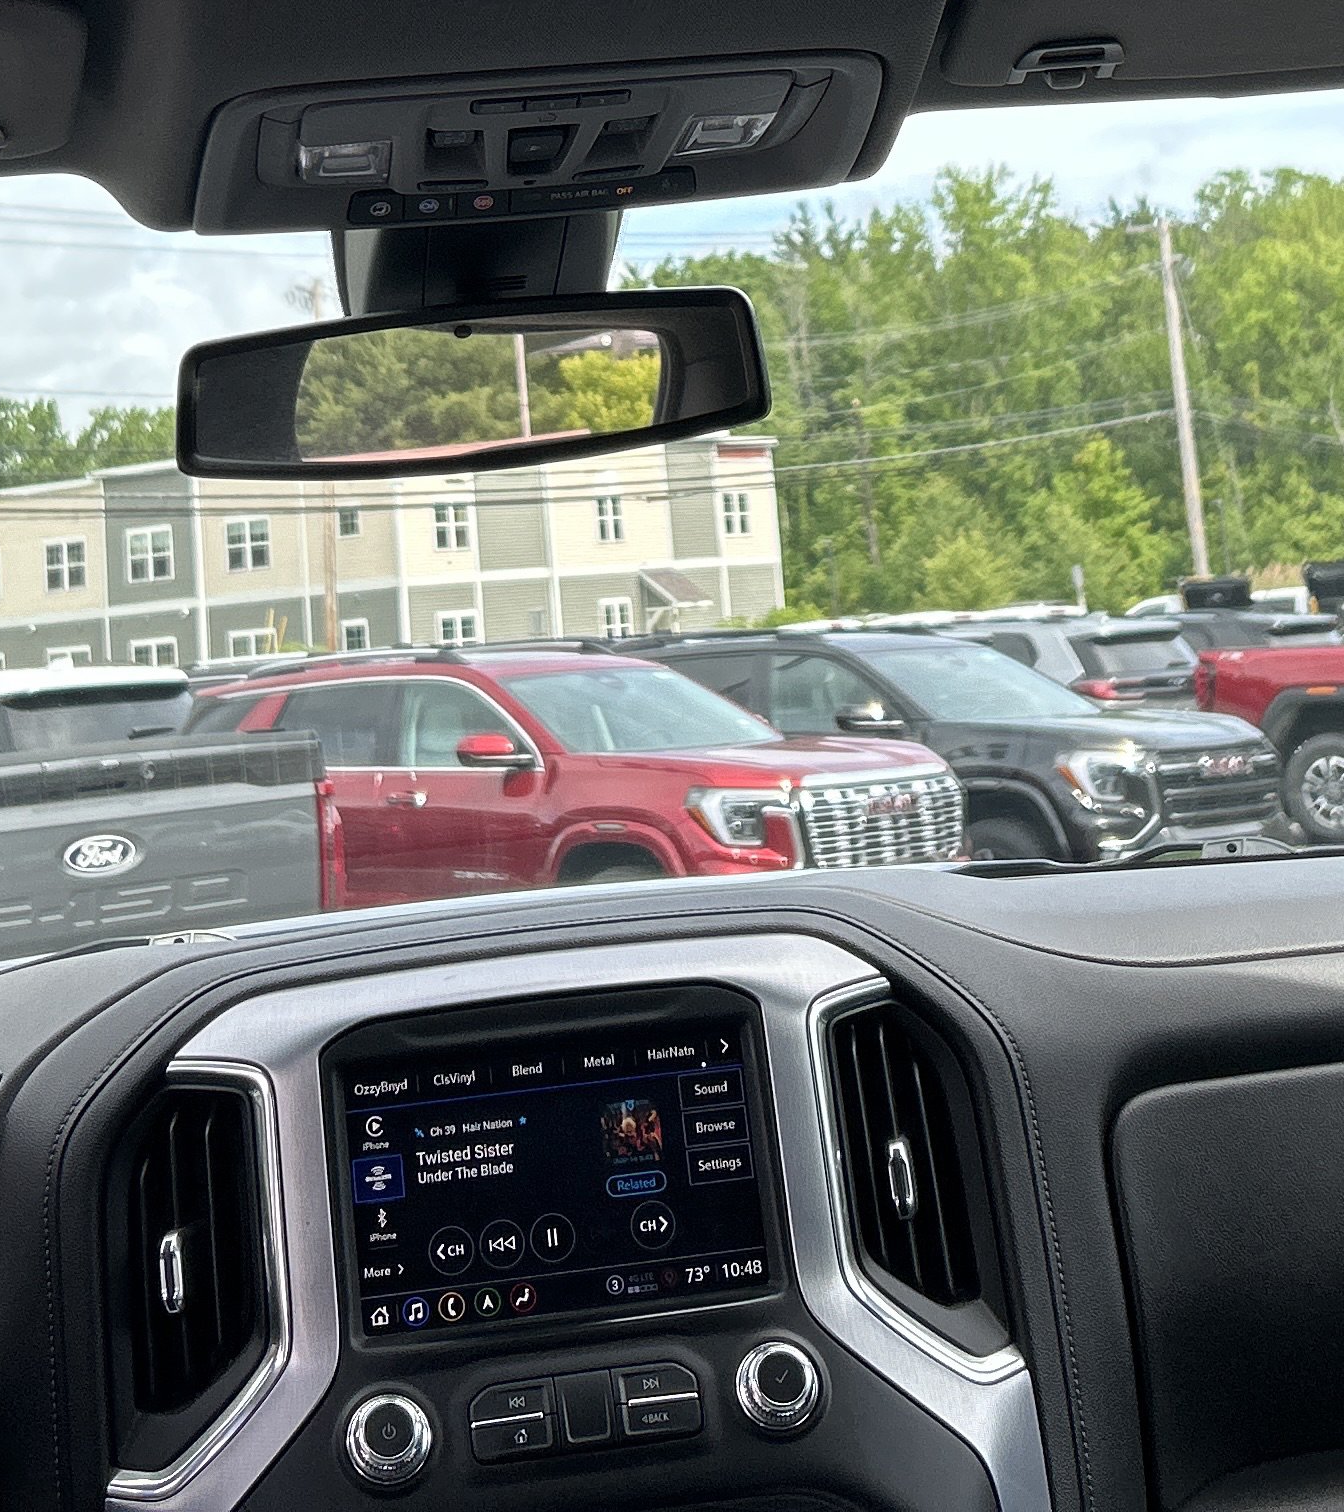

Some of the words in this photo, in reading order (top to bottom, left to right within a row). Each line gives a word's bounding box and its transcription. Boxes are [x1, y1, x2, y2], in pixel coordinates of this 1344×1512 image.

[551, 192, 573, 200] PASS
[575, 190, 589, 198] AIR
[616, 187, 634, 195] OFF
[583, 1053, 615, 1068] Metal
[647, 1045, 695, 1061] HairNatn
[512, 1061, 543, 1077] Blend
[433, 1069, 476, 1086] ClsVinyl
[354, 1078, 408, 1097] OzzyBnyd
[694, 1080, 728, 1096] Sound
[430, 1126, 443, 1137] Ch
[444, 1124, 456, 1135] 39
[462, 1121, 481, 1134] Hair
[482, 1118, 513, 1130] Nation
[695, 1120, 736, 1134] Browse
[362, 1141, 390, 1151] iPhone
[416, 1146, 471, 1166] Twisted
[474, 1142, 515, 1159] Sister
[417, 1169, 453, 1184] Under
[455, 1165, 478, 1180] The
[480, 1161, 514, 1177] Blade
[698, 1157, 742, 1172] Settings
[617, 1176, 657, 1192] Related
[639, 1219, 657, 1232] CH
[369, 1233, 397, 1243] iPhone
[447, 1244, 465, 1256] CH
[364, 1267, 391, 1279] More
[685, 1265, 711, 1283] 73°
[722, 1259, 763, 1279] 10:48
[648, 1412, 670, 1424] BACK
